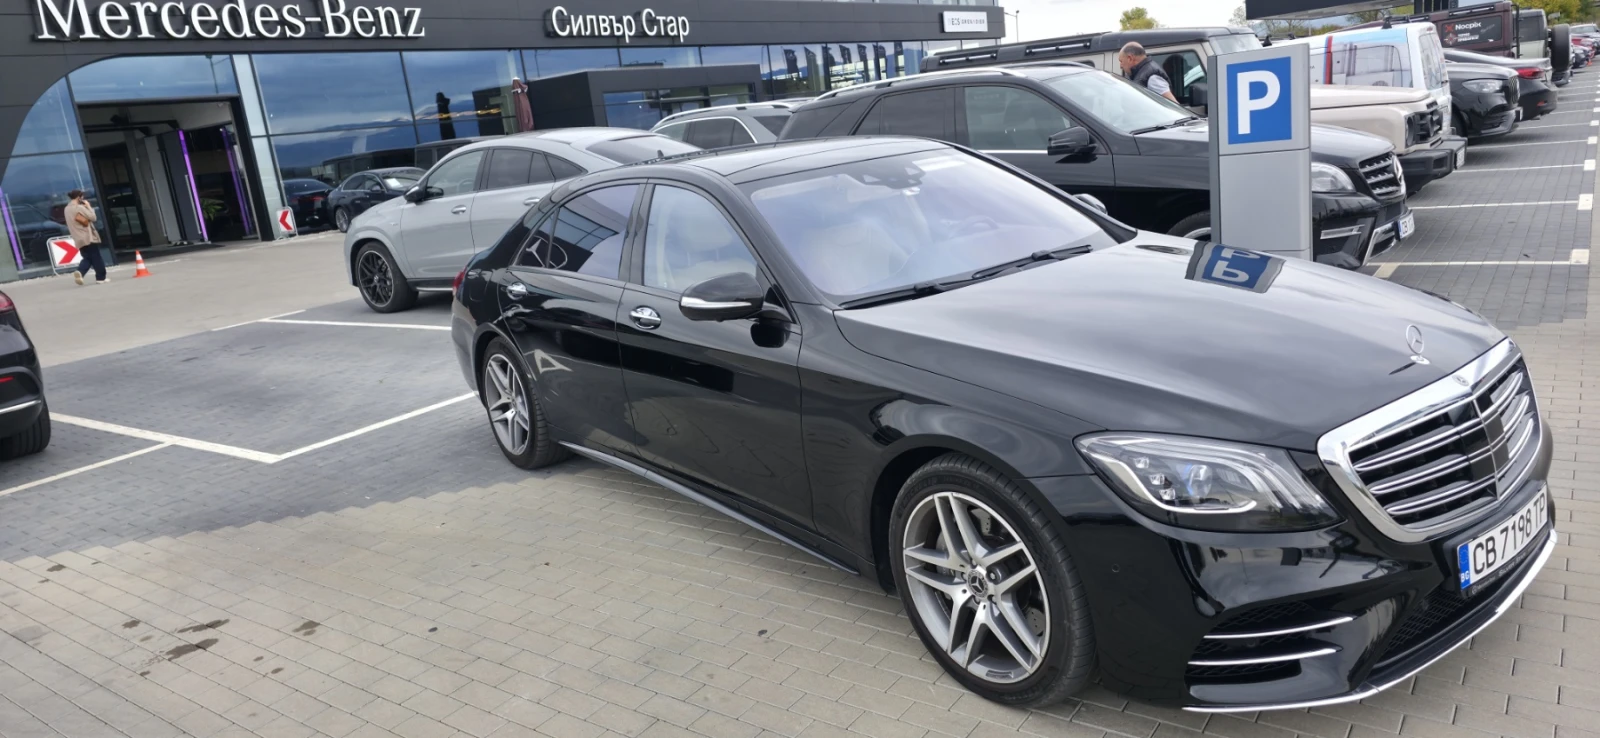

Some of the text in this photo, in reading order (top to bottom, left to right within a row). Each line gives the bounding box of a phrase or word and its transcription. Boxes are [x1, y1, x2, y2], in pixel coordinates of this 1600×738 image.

[37, 0, 425, 39] Mercedes-Benz
[552, 6, 690, 43] Силвър Стар
[1455, 22, 1482, 31] Nocpix
[1237, 70, 1281, 135] P
[1473, 492, 1546, 575] CB 7198 TP
